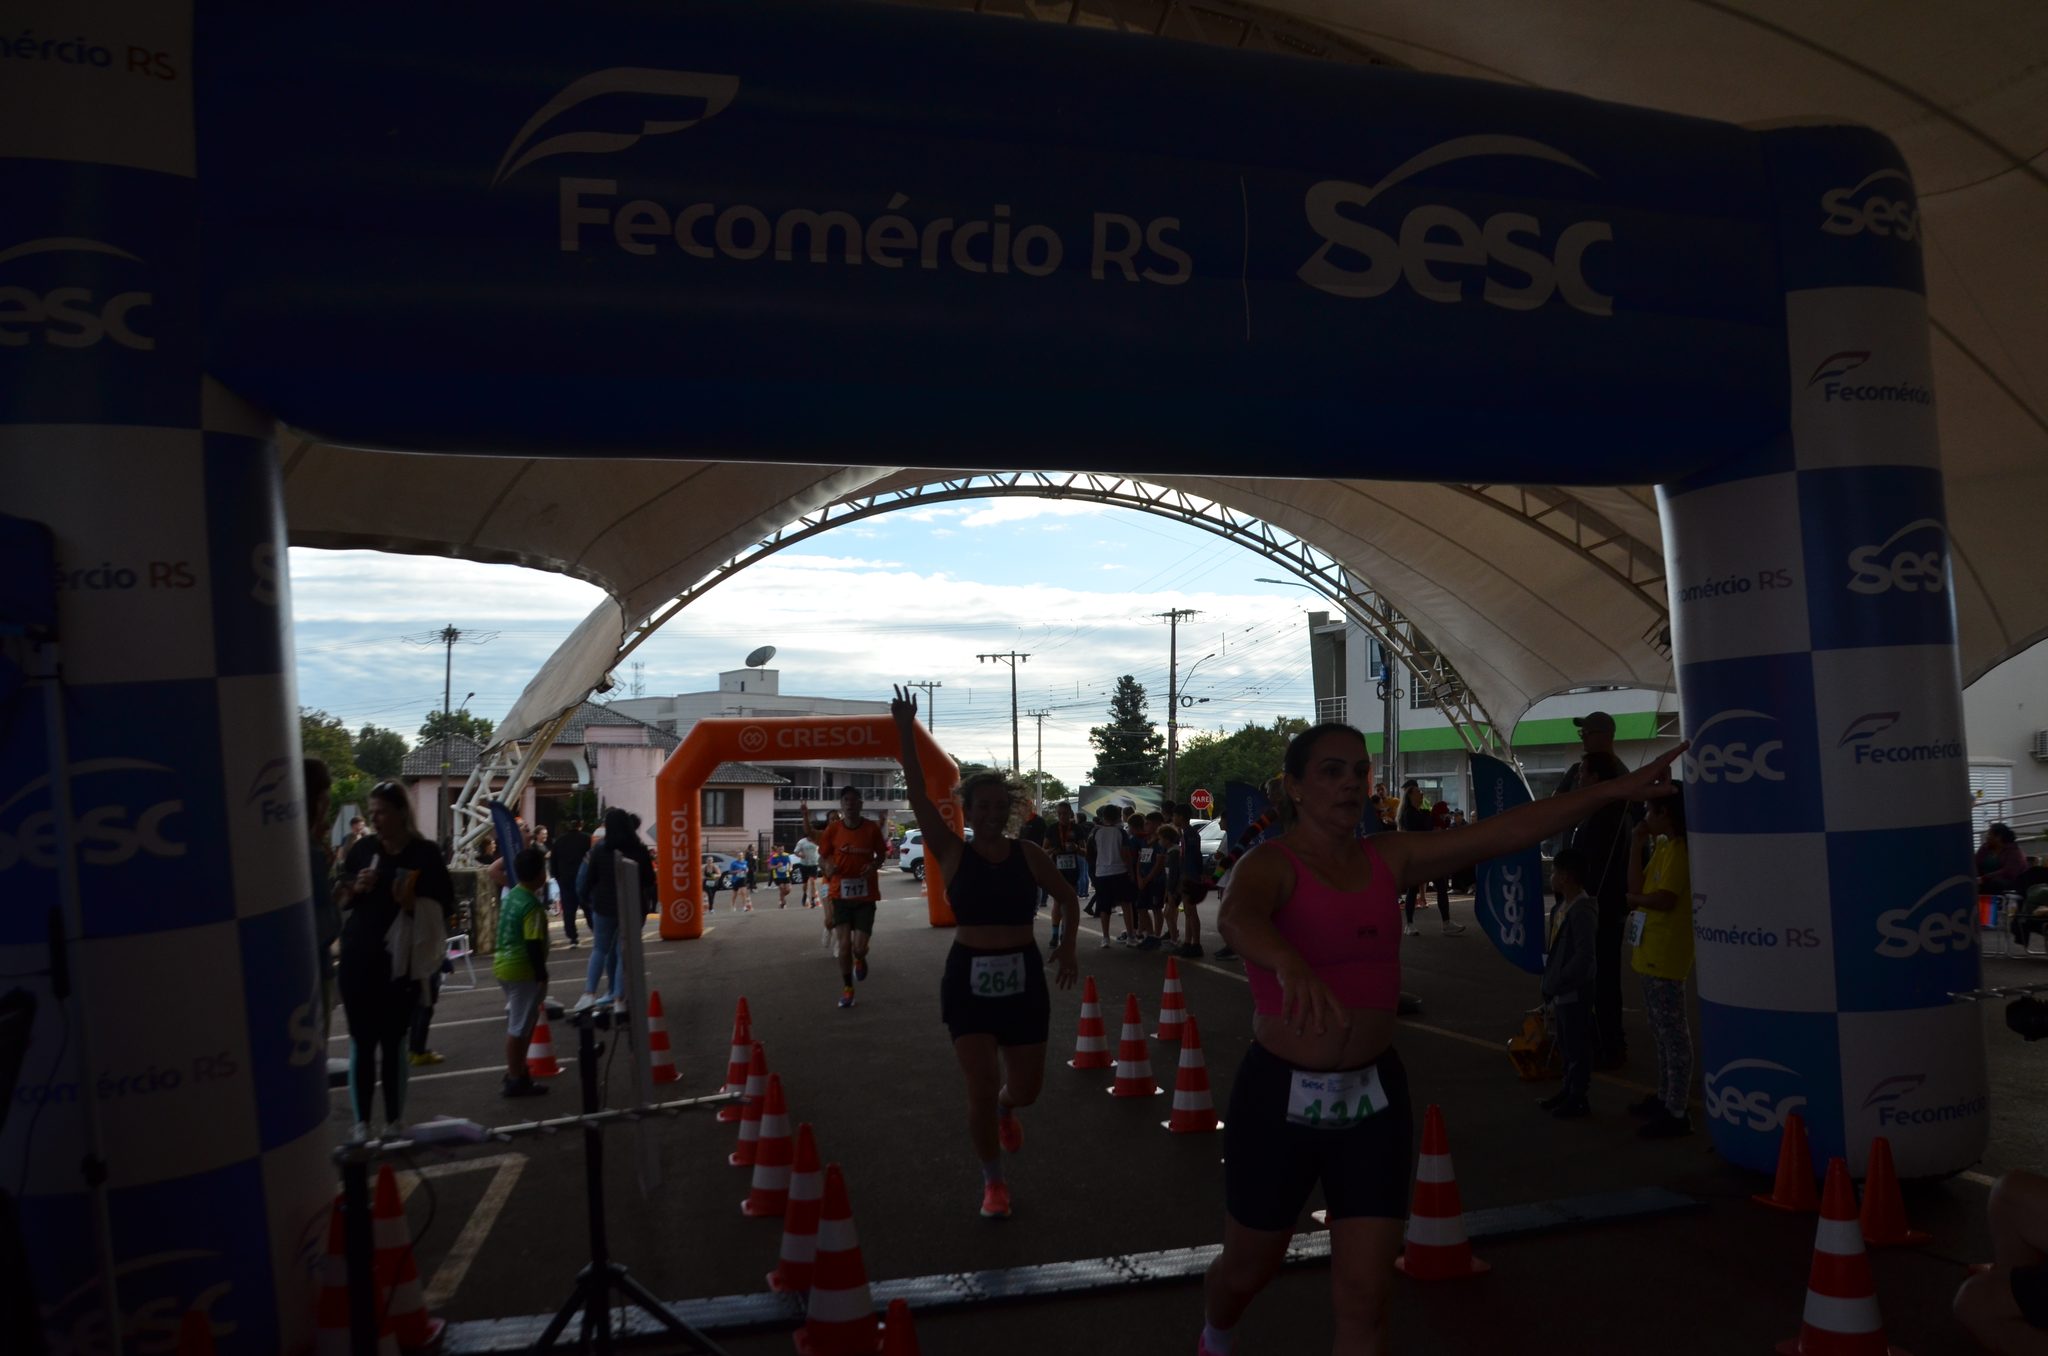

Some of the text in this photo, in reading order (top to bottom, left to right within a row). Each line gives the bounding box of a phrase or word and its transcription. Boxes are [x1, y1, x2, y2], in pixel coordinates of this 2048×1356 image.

[127, 45, 176, 81] RS
[558, 176, 1194, 286] Fecomércio RS
[1297, 178, 1615, 317] Sesc
[149, 561, 196, 590] RS
[1759, 568, 1793, 591] RS
[776, 725, 881, 748] CRESOL
[671, 804, 690, 892] CRESOL
[844, 884, 864, 896] 717
[1501, 864, 1526, 948] Sesc
[1785, 927, 1821, 949] RS
[979, 968, 1018, 993] 264
